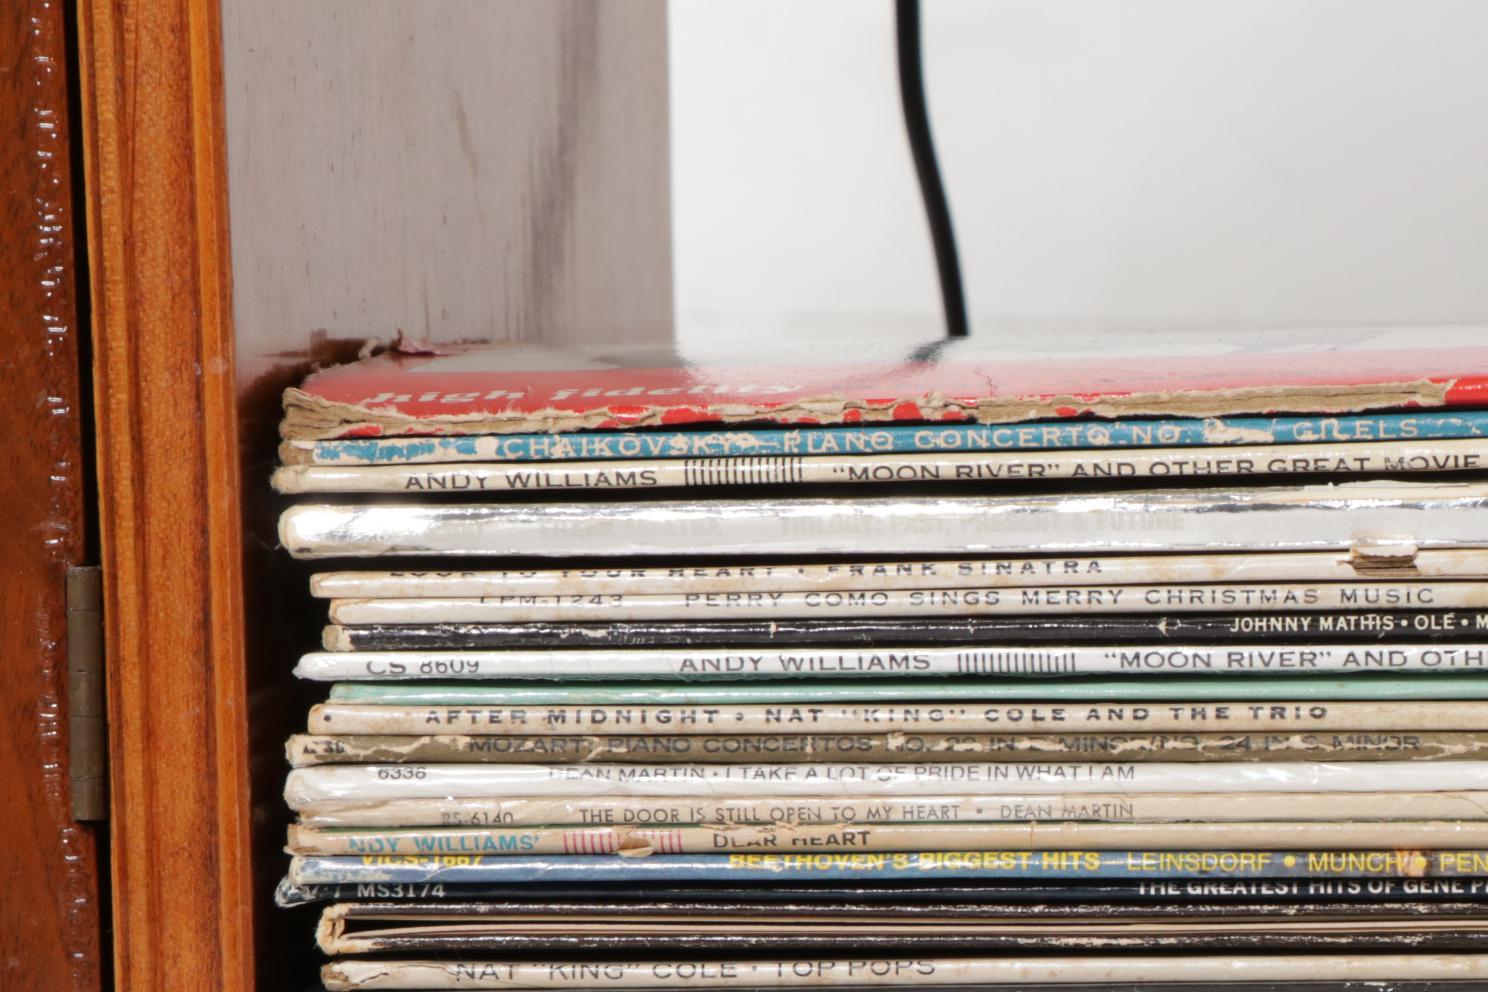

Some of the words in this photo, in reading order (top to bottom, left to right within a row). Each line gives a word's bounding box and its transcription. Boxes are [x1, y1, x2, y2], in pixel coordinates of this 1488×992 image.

[913, 424, 1112, 451] CONCERTO
[404, 470, 489, 490] ANDY
[503, 467, 660, 488] WILLIAMS
[1072, 460, 1137, 479] AND
[1148, 457, 1257, 477] OTHER
[1265, 455, 1371, 475] GREAT
[1384, 452, 1482, 472] MOVIE
[827, 562, 938, 576] FRANK
[957, 557, 1102, 576] SINATRA
[685, 592, 785, 608] PERRY
[804, 591, 889, 608] COMO
[909, 590, 1001, 607] SINGS
[1021, 588, 1123, 606] MERRY
[1144, 587, 1320, 605] CHRISTMAS
[1339, 586, 1435, 604] MUSIC
[1228, 616, 1311, 633] JOHNNY
[1318, 614, 1395, 632] MATHIS
[365, 659, 408, 676] CS
[679, 656, 767, 673] ANDY
[779, 654, 932, 672] WILLIAMS
[1342, 650, 1408, 668] AND
[425, 708, 529, 725] AFTER
[546, 707, 720, 725] MIDNIGHT
[764, 707, 826, 723] NAT
[983, 706, 1067, 722] COLE
[1085, 705, 1152, 722] AND
[1169, 705, 1231, 721] THE
[1248, 703, 1329, 720] TRIO
[607, 737, 693, 753] PIANO
[702, 736, 873, 753] CONCERTOS
[549, 767, 611, 782] DEAN
[617, 766, 705, 782] MARTIN
[740, 766, 796, 780] TAKE
[804, 766, 822, 780] A
[827, 766, 867, 780] LOT
[913, 765, 980, 780] PRIDE
[987, 765, 1010, 780] IN
[1017, 765, 1079, 780] WHAT
[1099, 764, 1135, 780] AM
[580, 809, 616, 824] THE
[623, 808, 681, 823] DOOR
[689, 807, 704, 822] IS
[714, 807, 759, 822] STILL
[769, 806, 823, 822] OPEN
[865, 805, 894, 821] MY
[902, 805, 961, 820] HEART
[999, 804, 1052, 820] DEAN
[1061, 803, 1134, 819] MARTIN
[790, 830, 872, 848] HEART
[922, 852, 1030, 871] BIGGEST
[1040, 851, 1102, 871] HITS
[1126, 851, 1272, 872] LEINSDORF
[1308, 851, 1403, 873] MUNCH
[357, 883, 446, 898] MS3174
[1137, 881, 1182, 896] THE
[1187, 881, 1300, 895] GREATEST
[1308, 881, 1359, 895] HITS
[1366, 881, 1398, 895] OF
[1402, 880, 1465, 895] GENE
[457, 962, 522, 980] NAT
[651, 961, 739, 979] COLE
[774, 960, 838, 977] TOP
[848, 958, 938, 976] POPS
